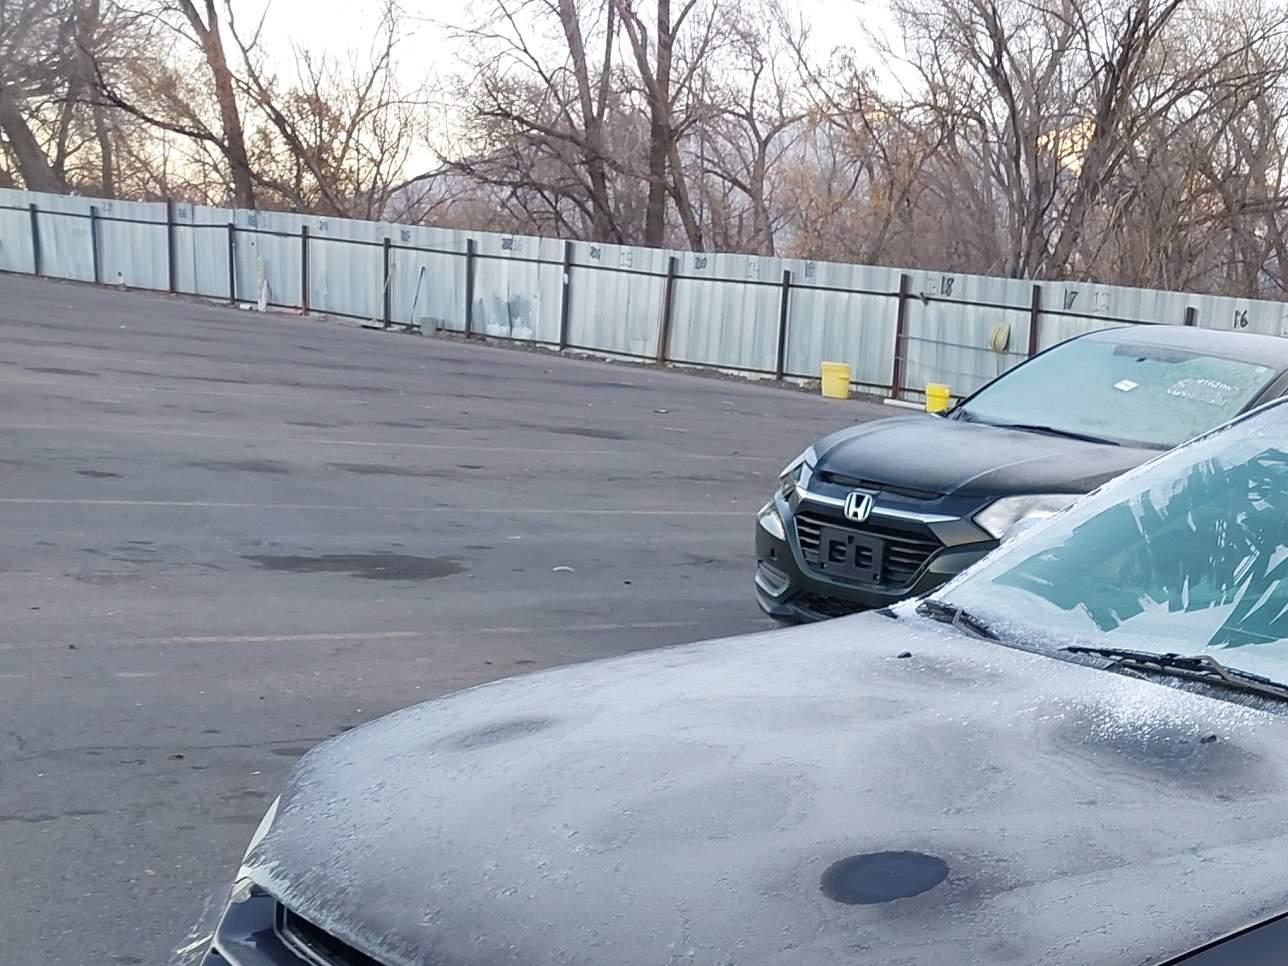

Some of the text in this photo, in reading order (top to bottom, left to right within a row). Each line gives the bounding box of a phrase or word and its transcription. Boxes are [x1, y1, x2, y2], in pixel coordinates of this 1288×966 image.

[940, 275, 955, 297] 18
[1063, 287, 1079, 310] 17
[1233, 308, 1249, 329] 16
